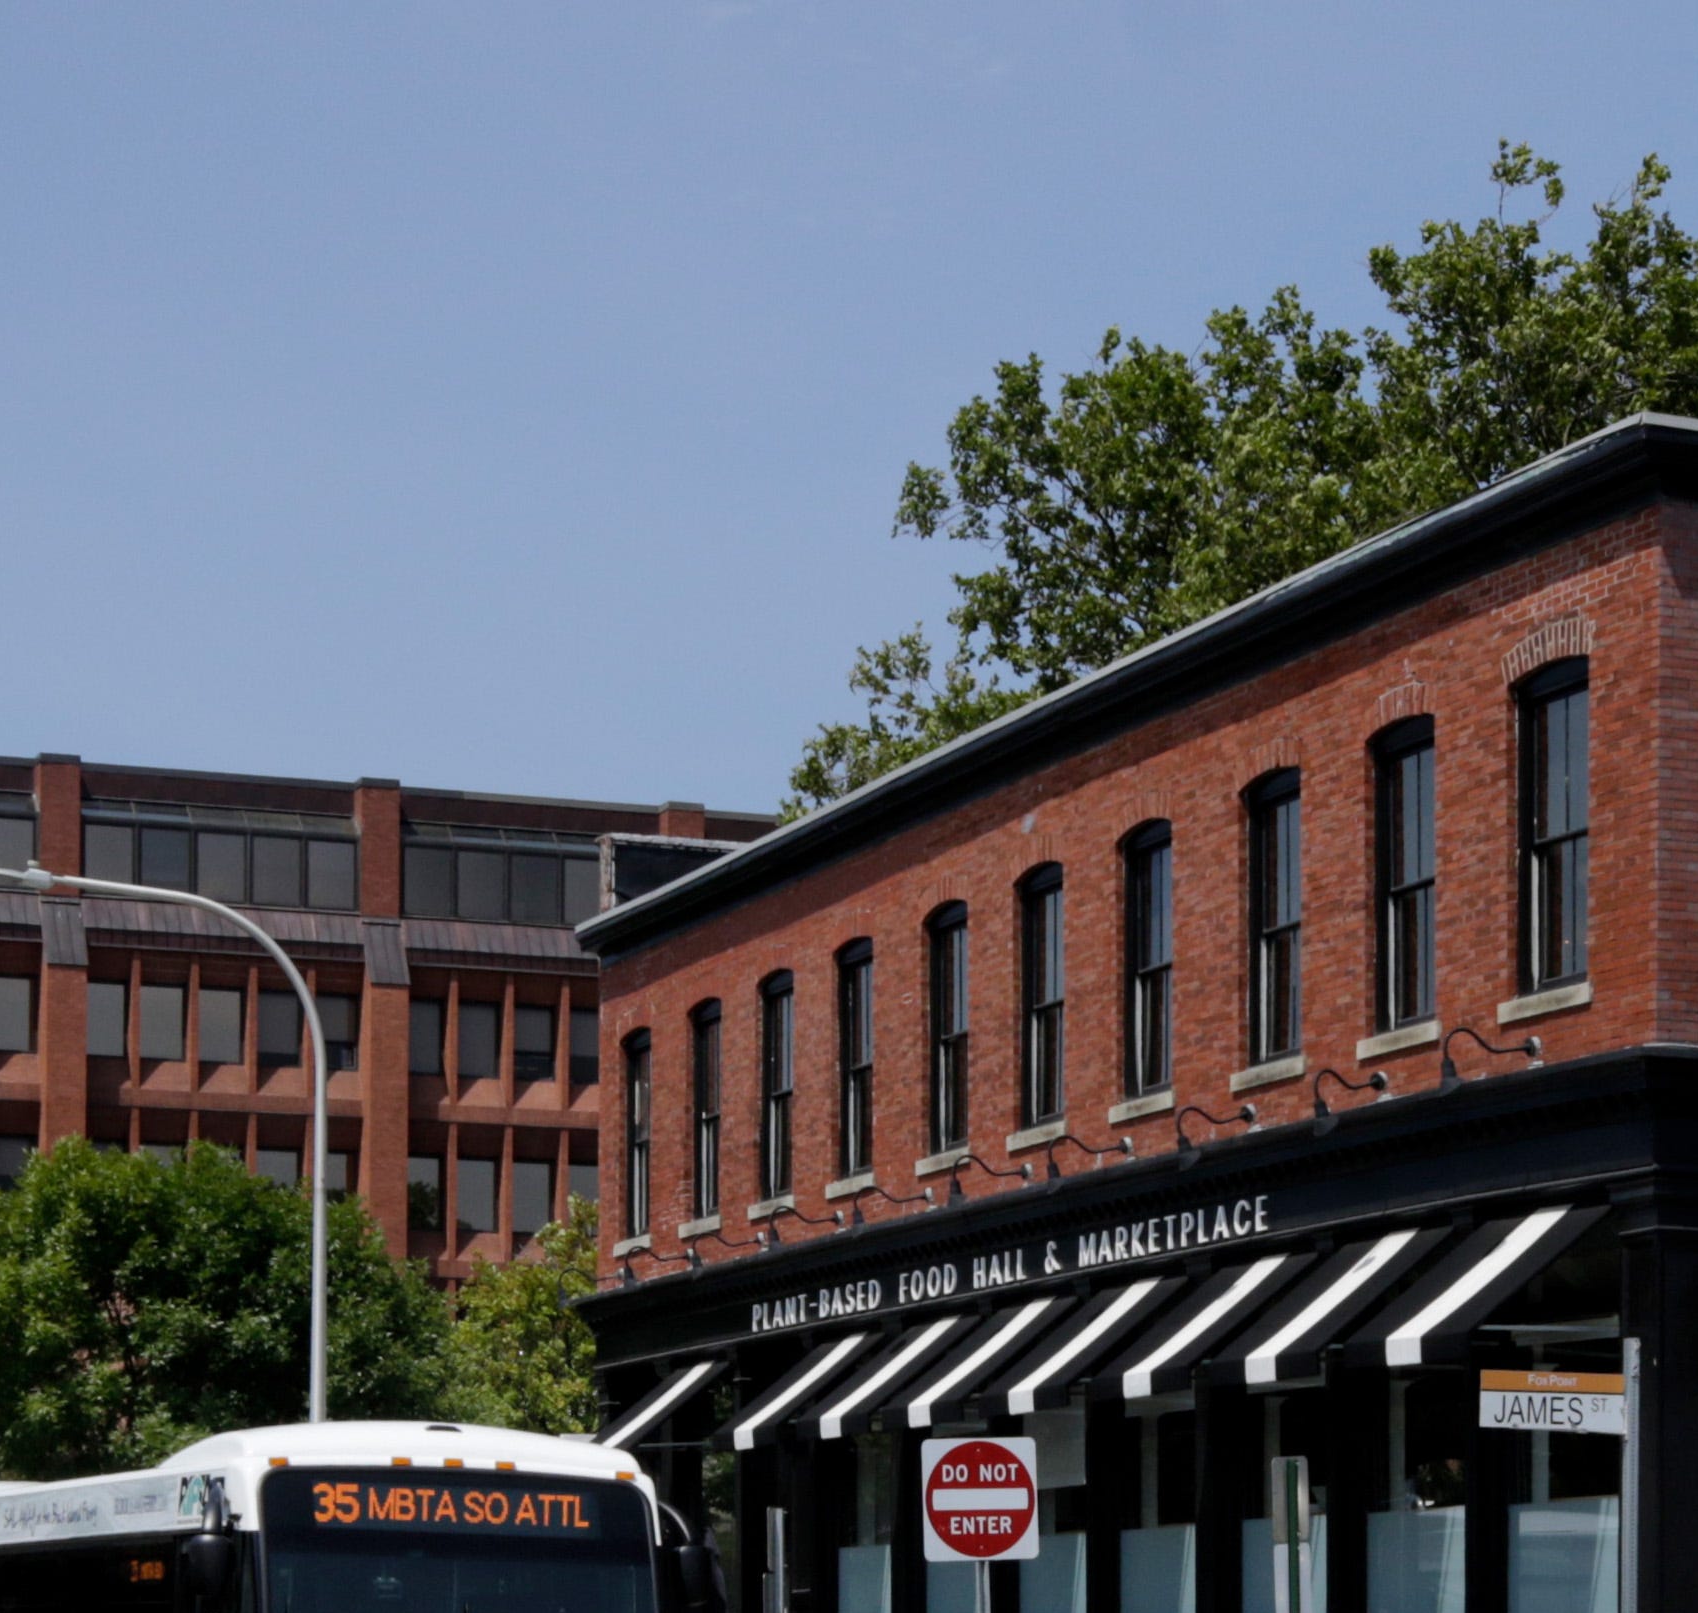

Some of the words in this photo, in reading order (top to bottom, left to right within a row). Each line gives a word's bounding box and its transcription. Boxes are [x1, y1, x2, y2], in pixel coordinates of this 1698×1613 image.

[751, 1279, 882, 1333] PLANT-BASED
[899, 1263, 958, 1306] FOOD
[972, 1248, 1028, 1291] HALL
[1044, 1241, 1061, 1274] &
[1078, 1195, 1269, 1268] MARKETPLACE
[1494, 1395, 1584, 1426] JAMES
[942, 1463, 969, 1483] DO
[979, 1463, 1019, 1482] NOT
[312, 1482, 360, 1523] 35
[368, 1486, 458, 1523] MBTA
[463, 1490, 509, 1525] SO
[514, 1493, 590, 1528] ATTL
[950, 1515, 1013, 1535] ENTER
